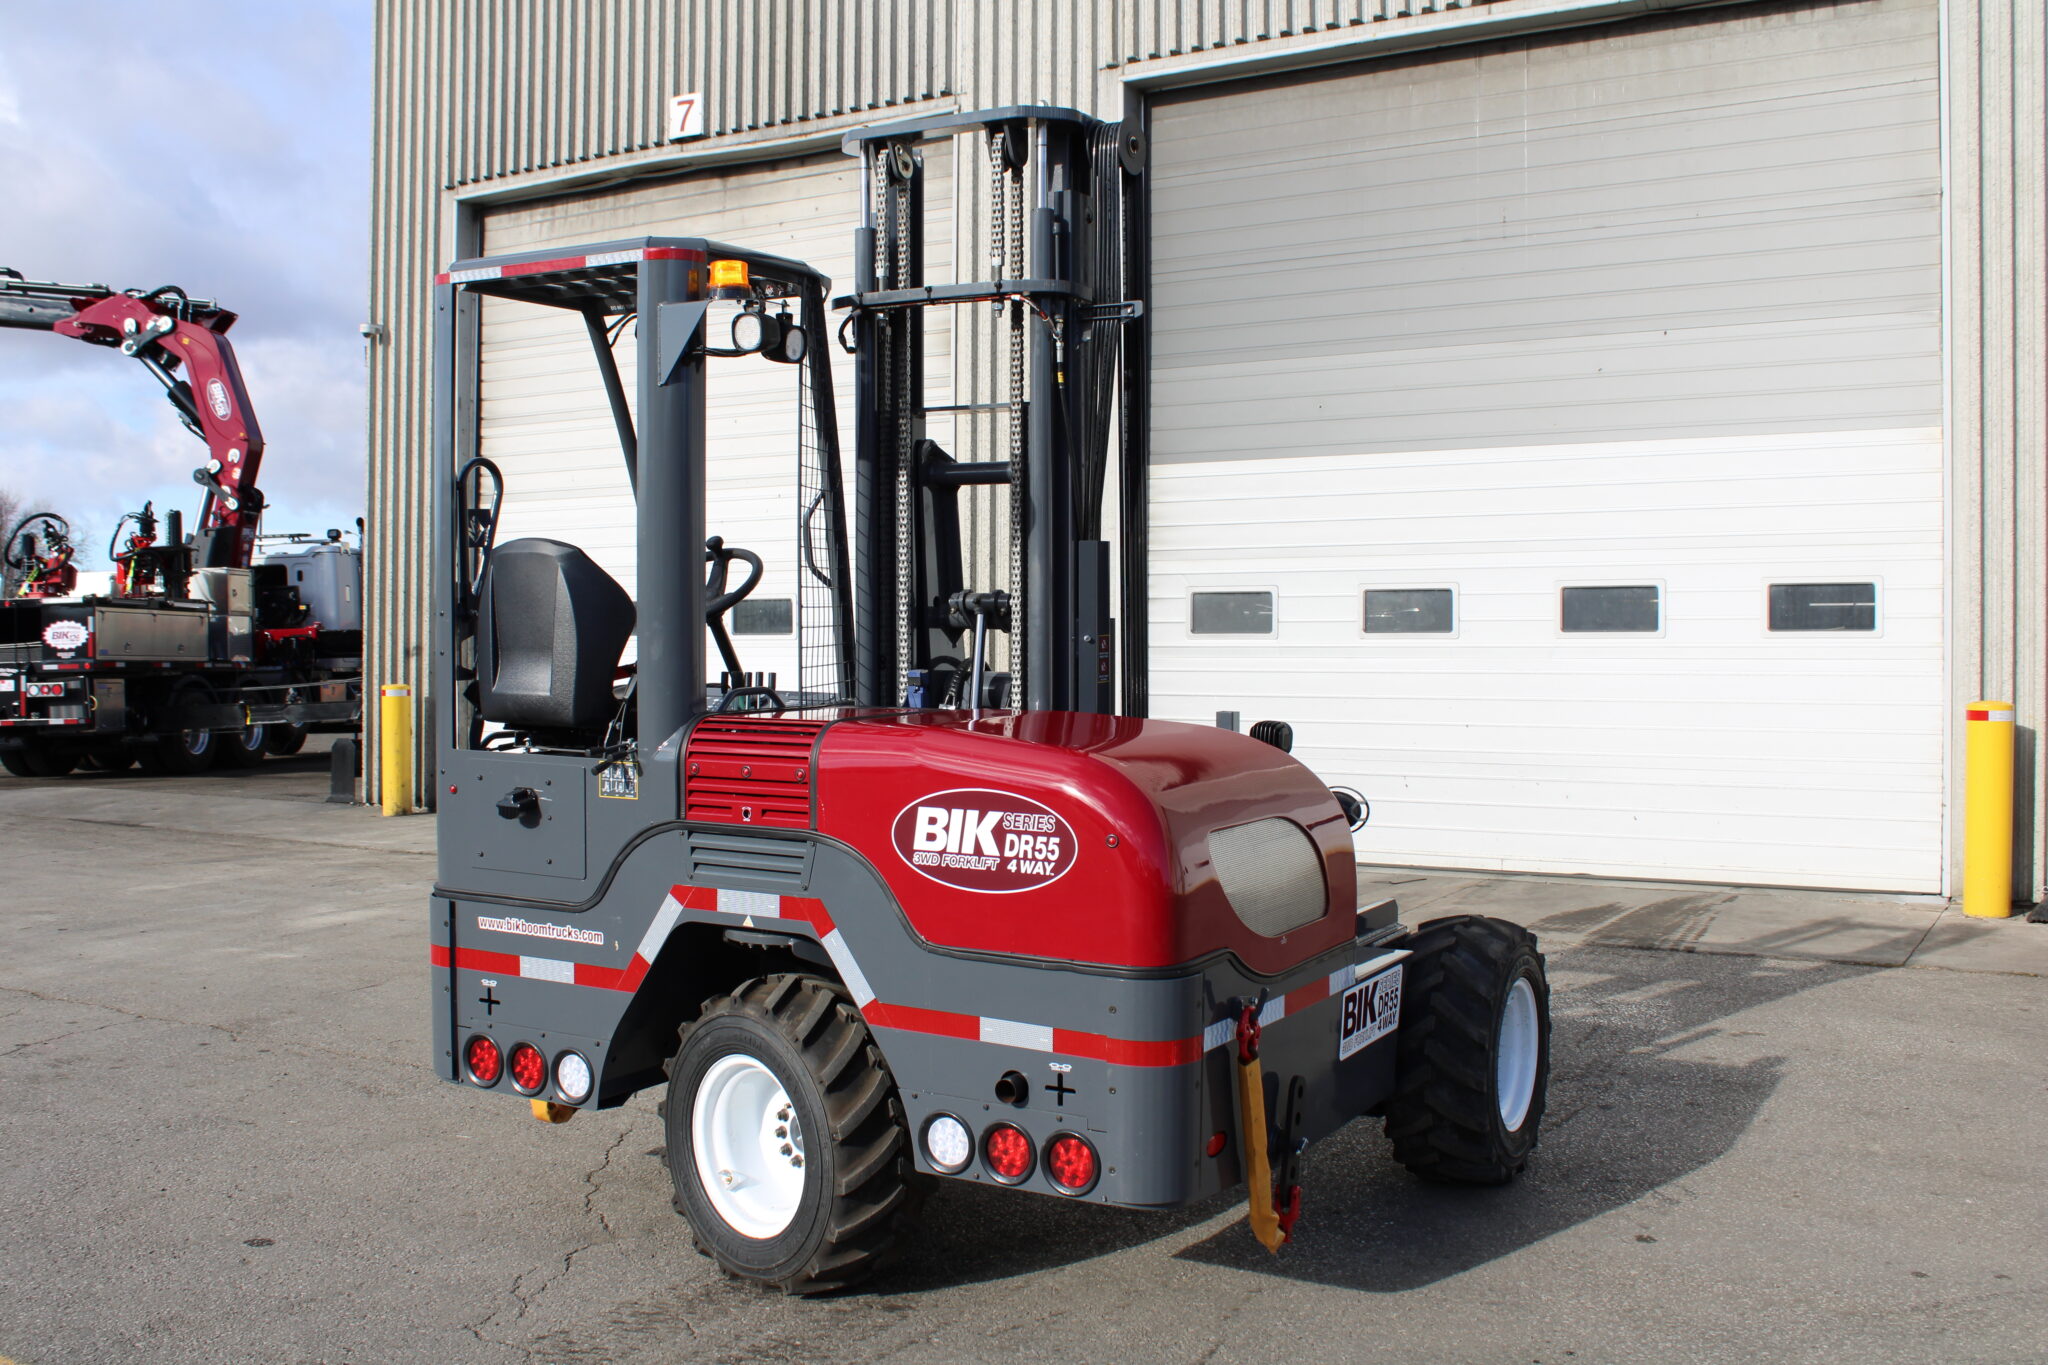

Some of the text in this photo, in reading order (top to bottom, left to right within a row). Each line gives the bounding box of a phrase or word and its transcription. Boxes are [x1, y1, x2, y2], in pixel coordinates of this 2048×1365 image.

[677, 99, 695, 132] 7
[51, 631, 70, 640] BIK
[913, 806, 1004, 857] BIK
[1003, 812, 1055, 832] SERIES
[1004, 833, 1060, 861] DR55
[912, 851, 1000, 871] 3WD FORKLIFT
[1006, 859, 1018, 873] 4
[478, 917, 603, 944] www.bikboomtrucks.com
[1343, 980, 1379, 1040] BIK
[1378, 987, 1399, 1018] DR55
[1377, 1017, 1382, 1032] 4
